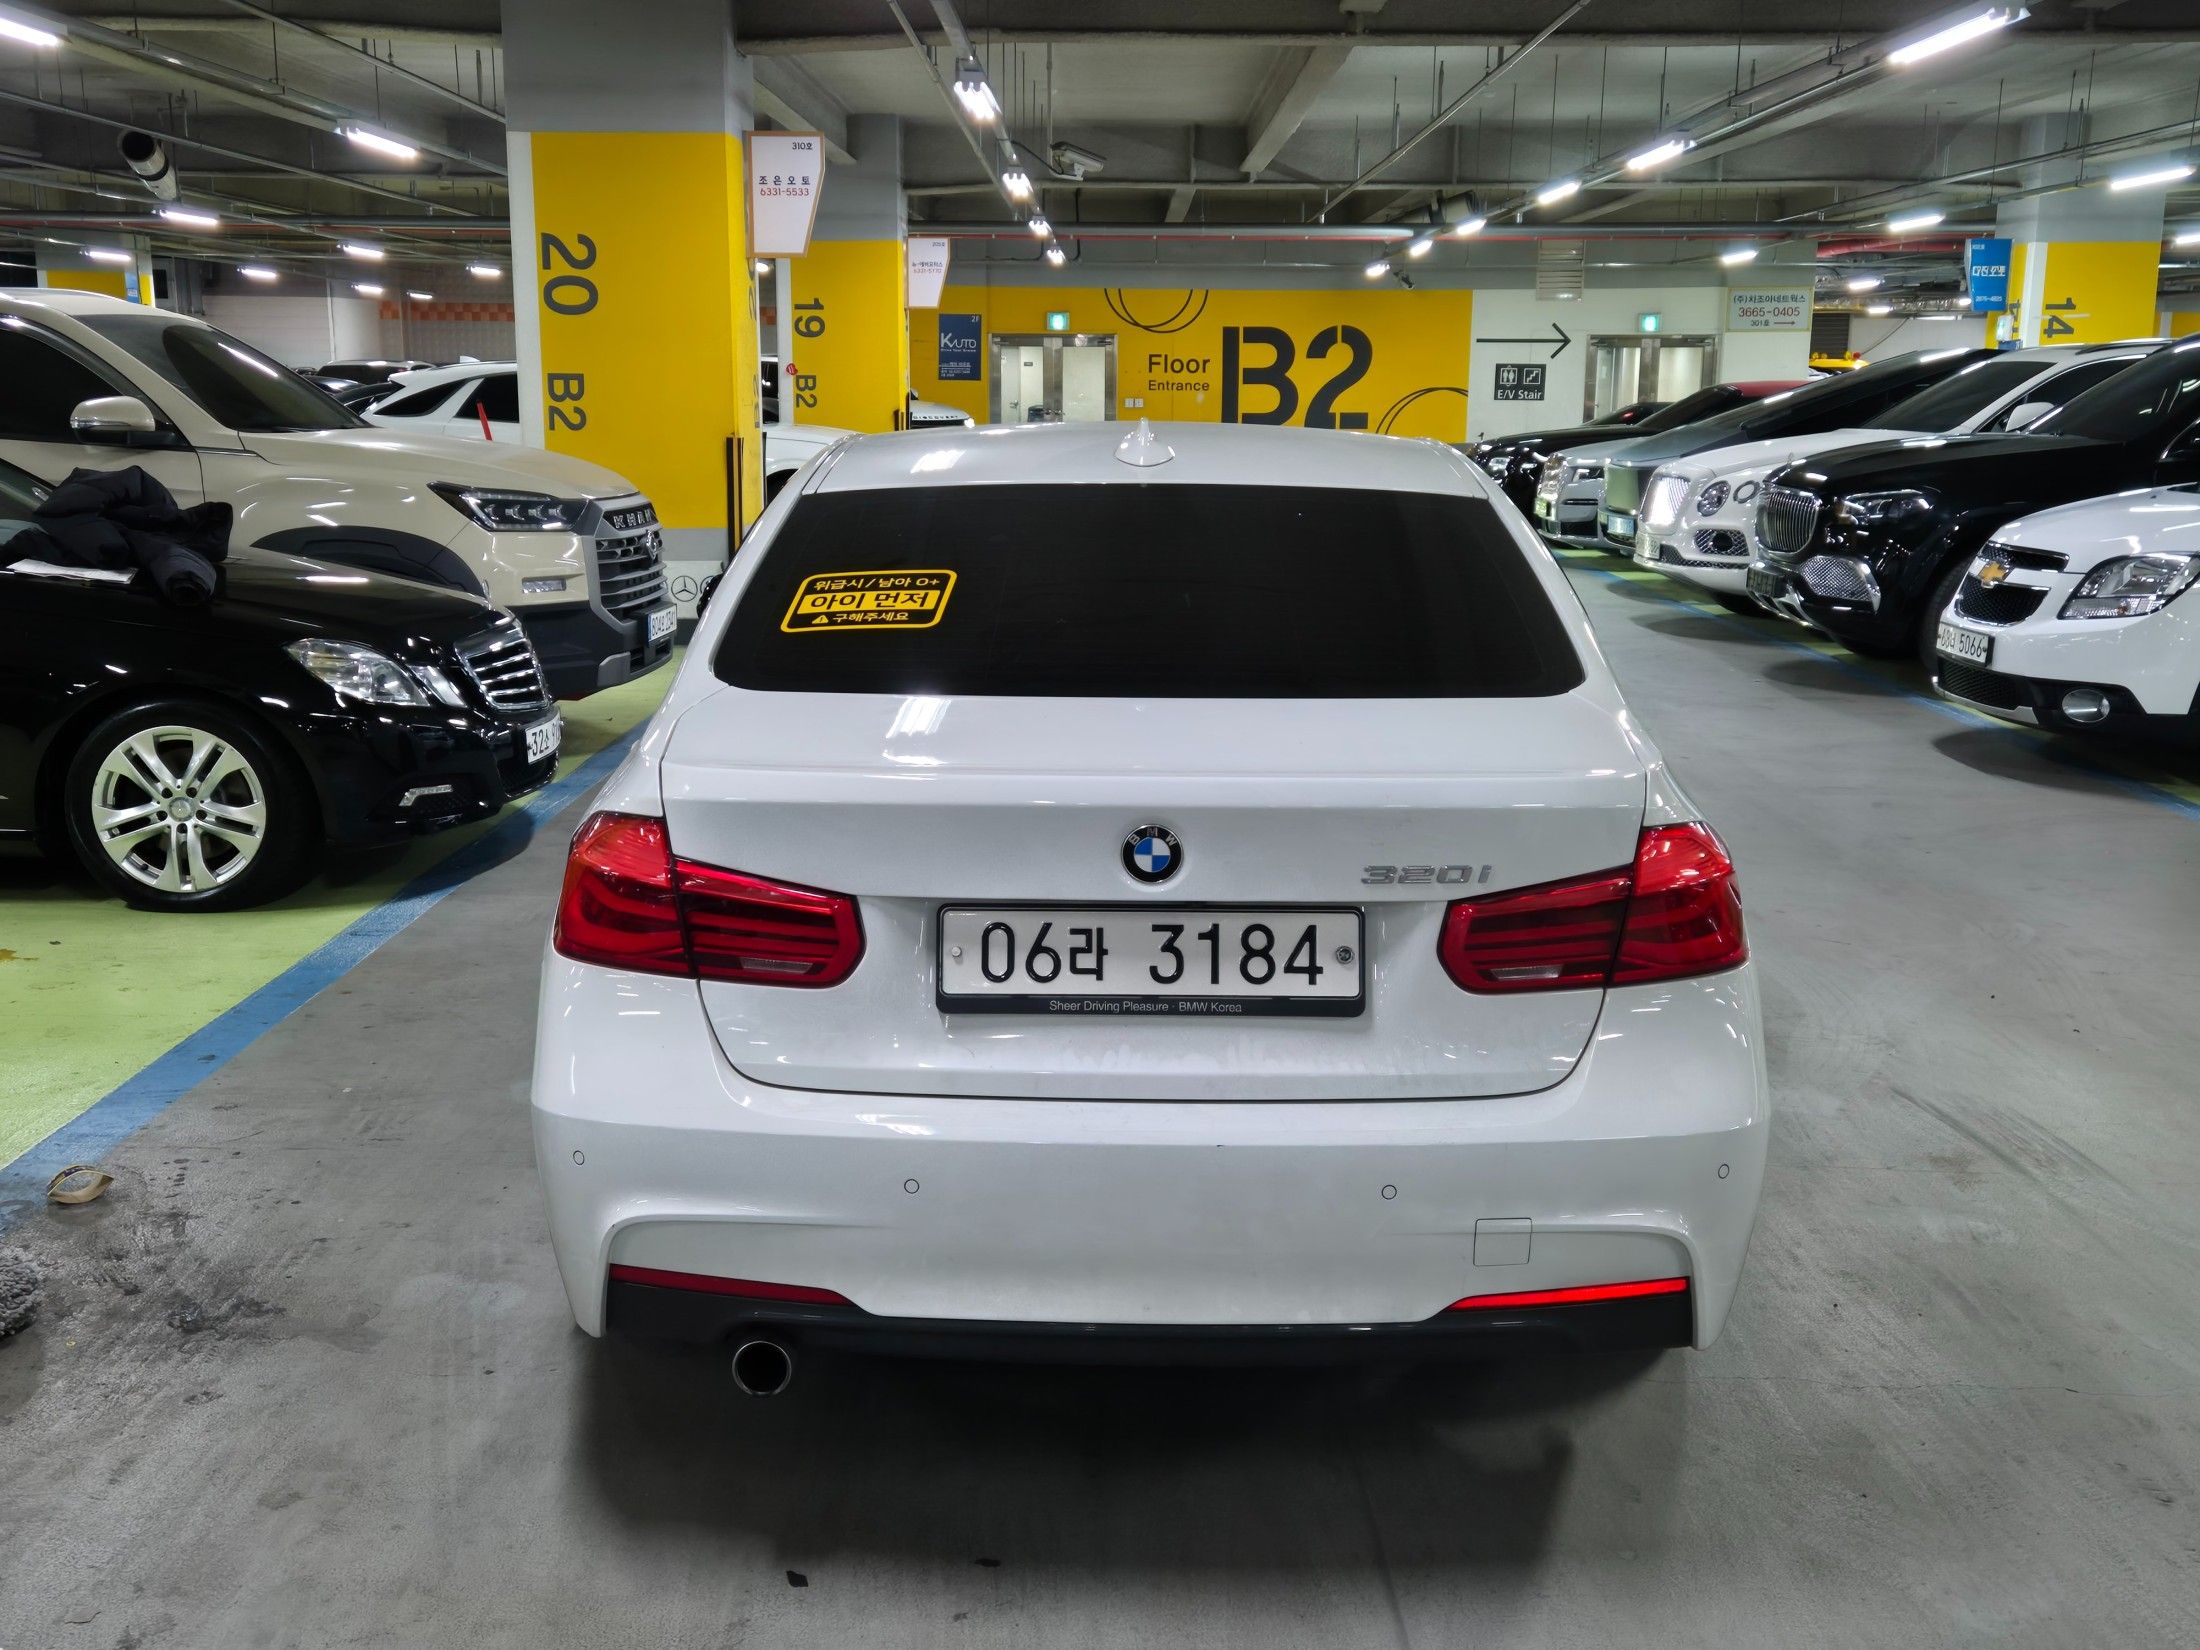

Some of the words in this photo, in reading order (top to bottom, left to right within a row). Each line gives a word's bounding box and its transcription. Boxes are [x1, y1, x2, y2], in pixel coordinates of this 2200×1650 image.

[792, 142, 813, 150] 310호
[760, 188, 809, 196] 6331-5533
[541, 232, 599, 316] 20
[794, 298, 826, 338] 19
[1739, 307, 1800, 317] 3665-0405
[2043, 297, 2077, 338] 14
[1148, 353, 1211, 374] Floor
[1148, 379, 1210, 392] Entrance
[1221, 325, 1373, 430] B2
[796, 375, 817, 408] B2
[1497, 389, 1516, 399] E/V
[1518, 389, 1541, 399] Stair
[547, 373, 587, 431] B2
[811, 593, 866, 610] 아이
[874, 592, 929, 608] 먼저
[833, 612, 909, 623] 구해주세요
[1959, 634, 1984, 657] 5066
[1128, 826, 1178, 846] BMW
[1360, 864, 1493, 884] 320i
[980, 922, 1109, 983] 06라
[1149, 923, 1324, 985] 3184
[1050, 1000, 1080, 1011] Sheer
[1084, 1001, 1120, 1013] Driving
[1123, 1001, 1169, 1012] Pleasure
[1179, 1002, 1208, 1012] BMW
[1211, 1002, 1242, 1012] Korea
